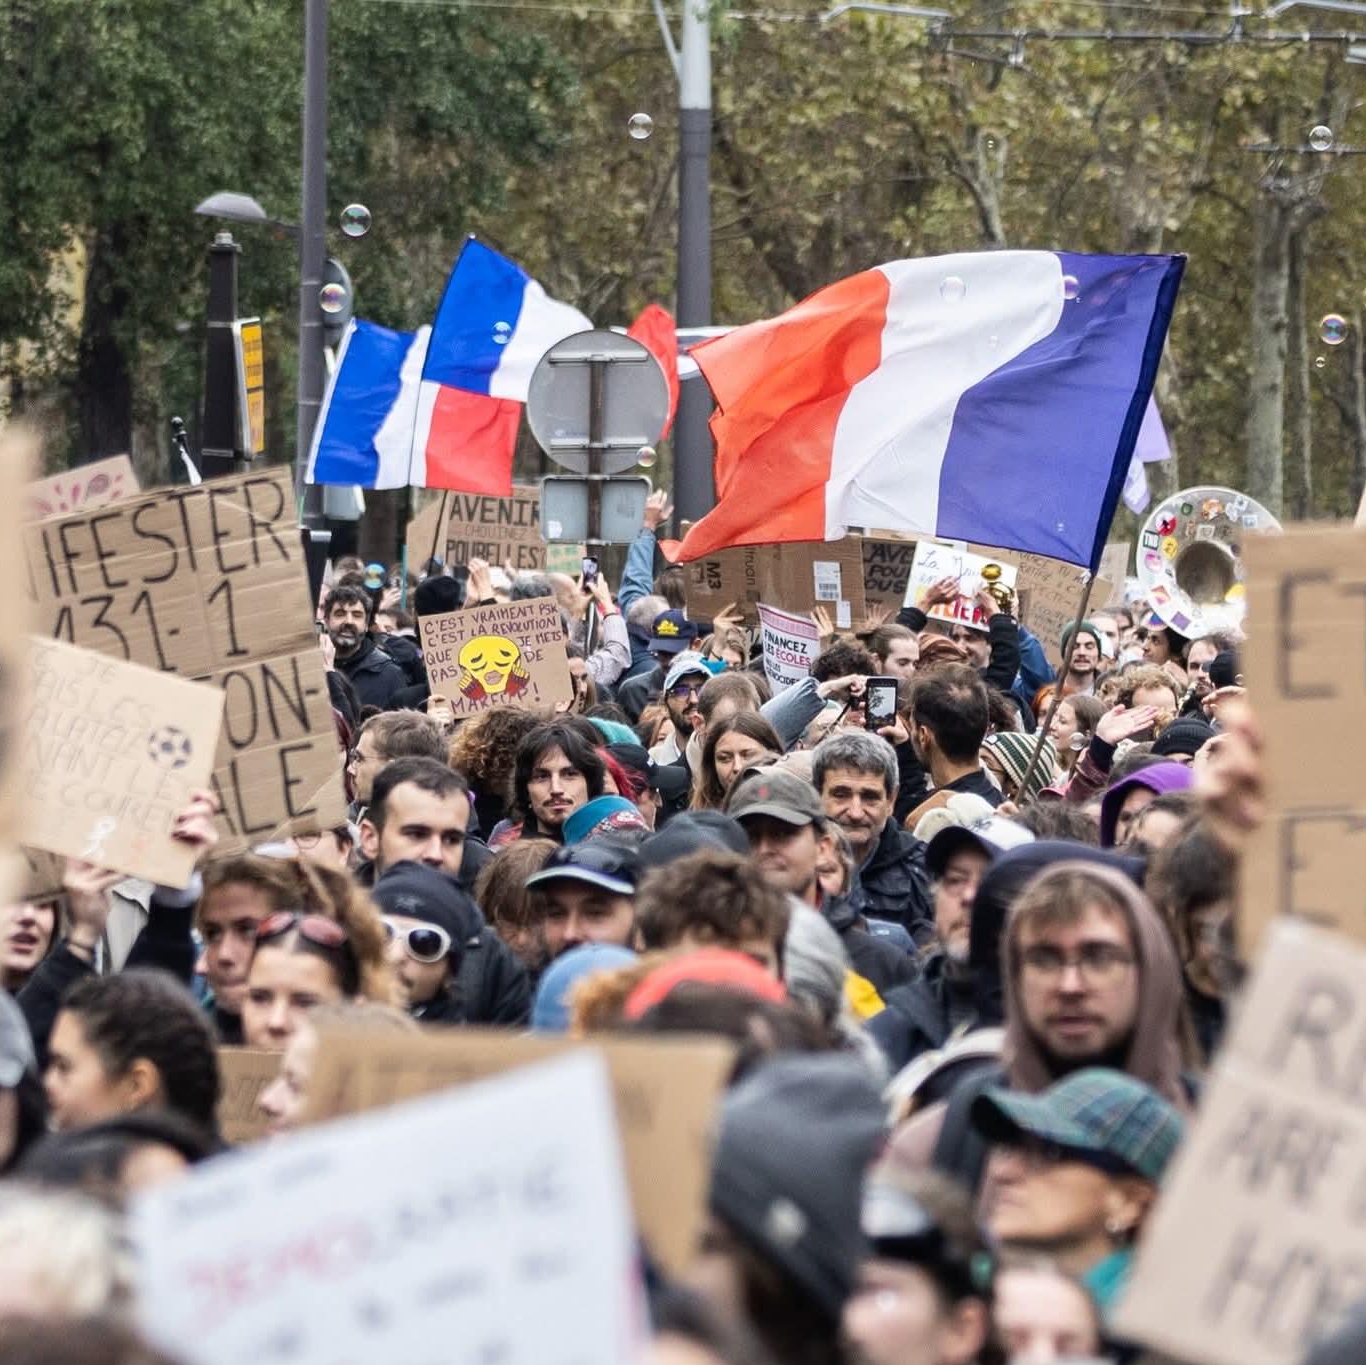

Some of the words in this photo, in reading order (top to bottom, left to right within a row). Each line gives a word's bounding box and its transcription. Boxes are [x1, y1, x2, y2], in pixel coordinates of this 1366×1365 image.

[41, 479, 290, 598] IFESTER
[424, 616, 465, 635] C'EST
[428, 630, 466, 647] C'EST
[426, 648, 452, 666] QUE
[516, 636, 532, 647] JE
[764, 629, 808, 655] FINANCEZ
[431, 666, 458, 684] PAS
[524, 649, 544, 664] DE
